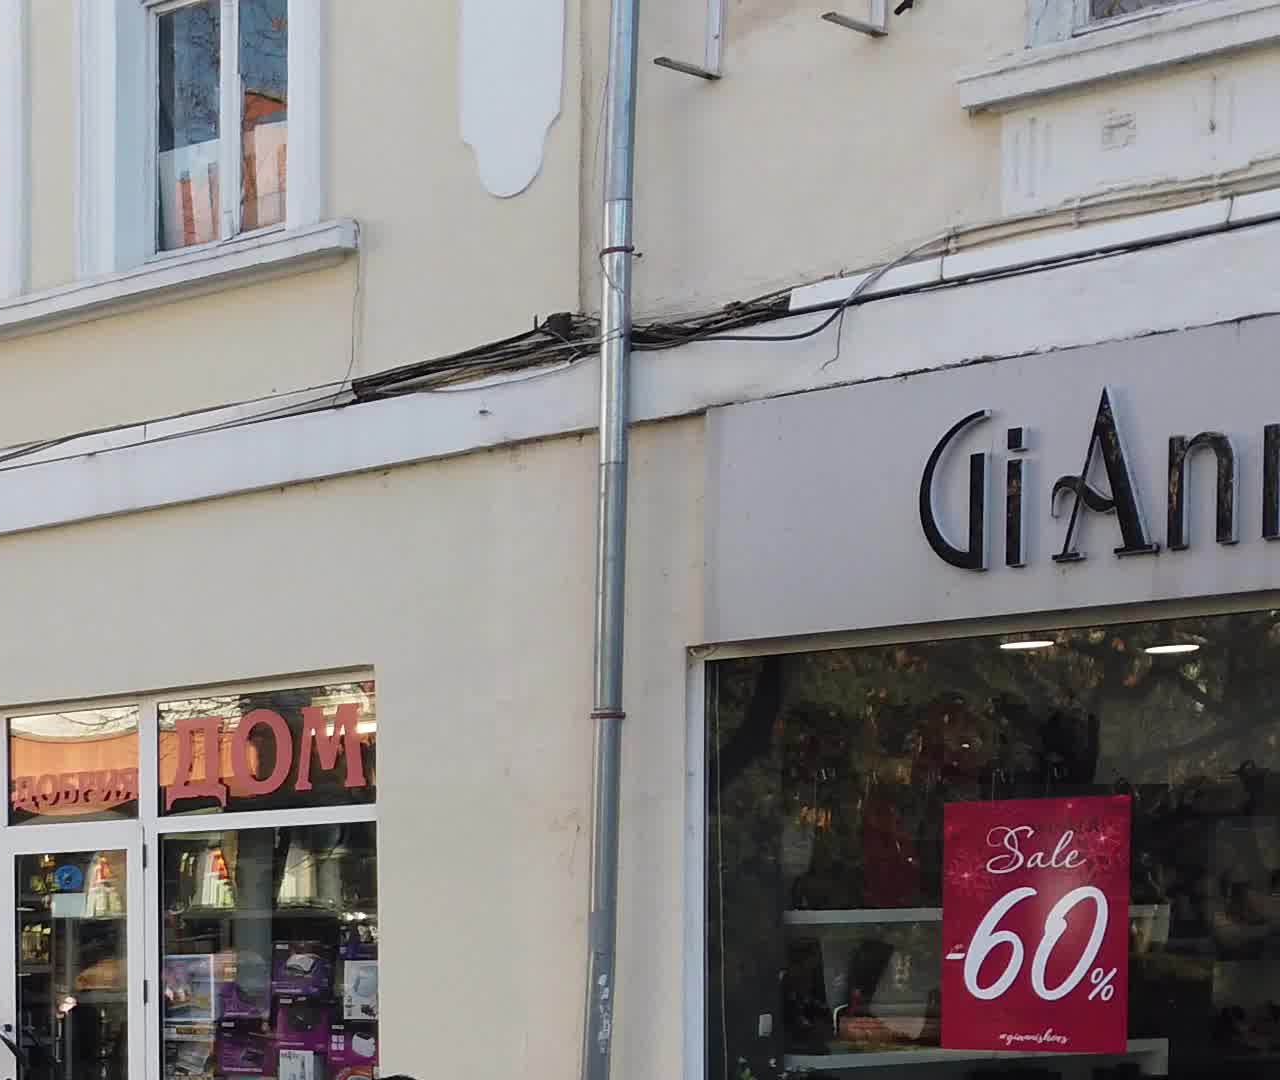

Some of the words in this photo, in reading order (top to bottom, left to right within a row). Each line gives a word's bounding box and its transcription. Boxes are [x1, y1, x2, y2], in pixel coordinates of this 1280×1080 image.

[165, 703, 367, 810] ДОМ
[986, 826, 1087, 874] Sale
[946, 886, 1117, 1000] -60%
